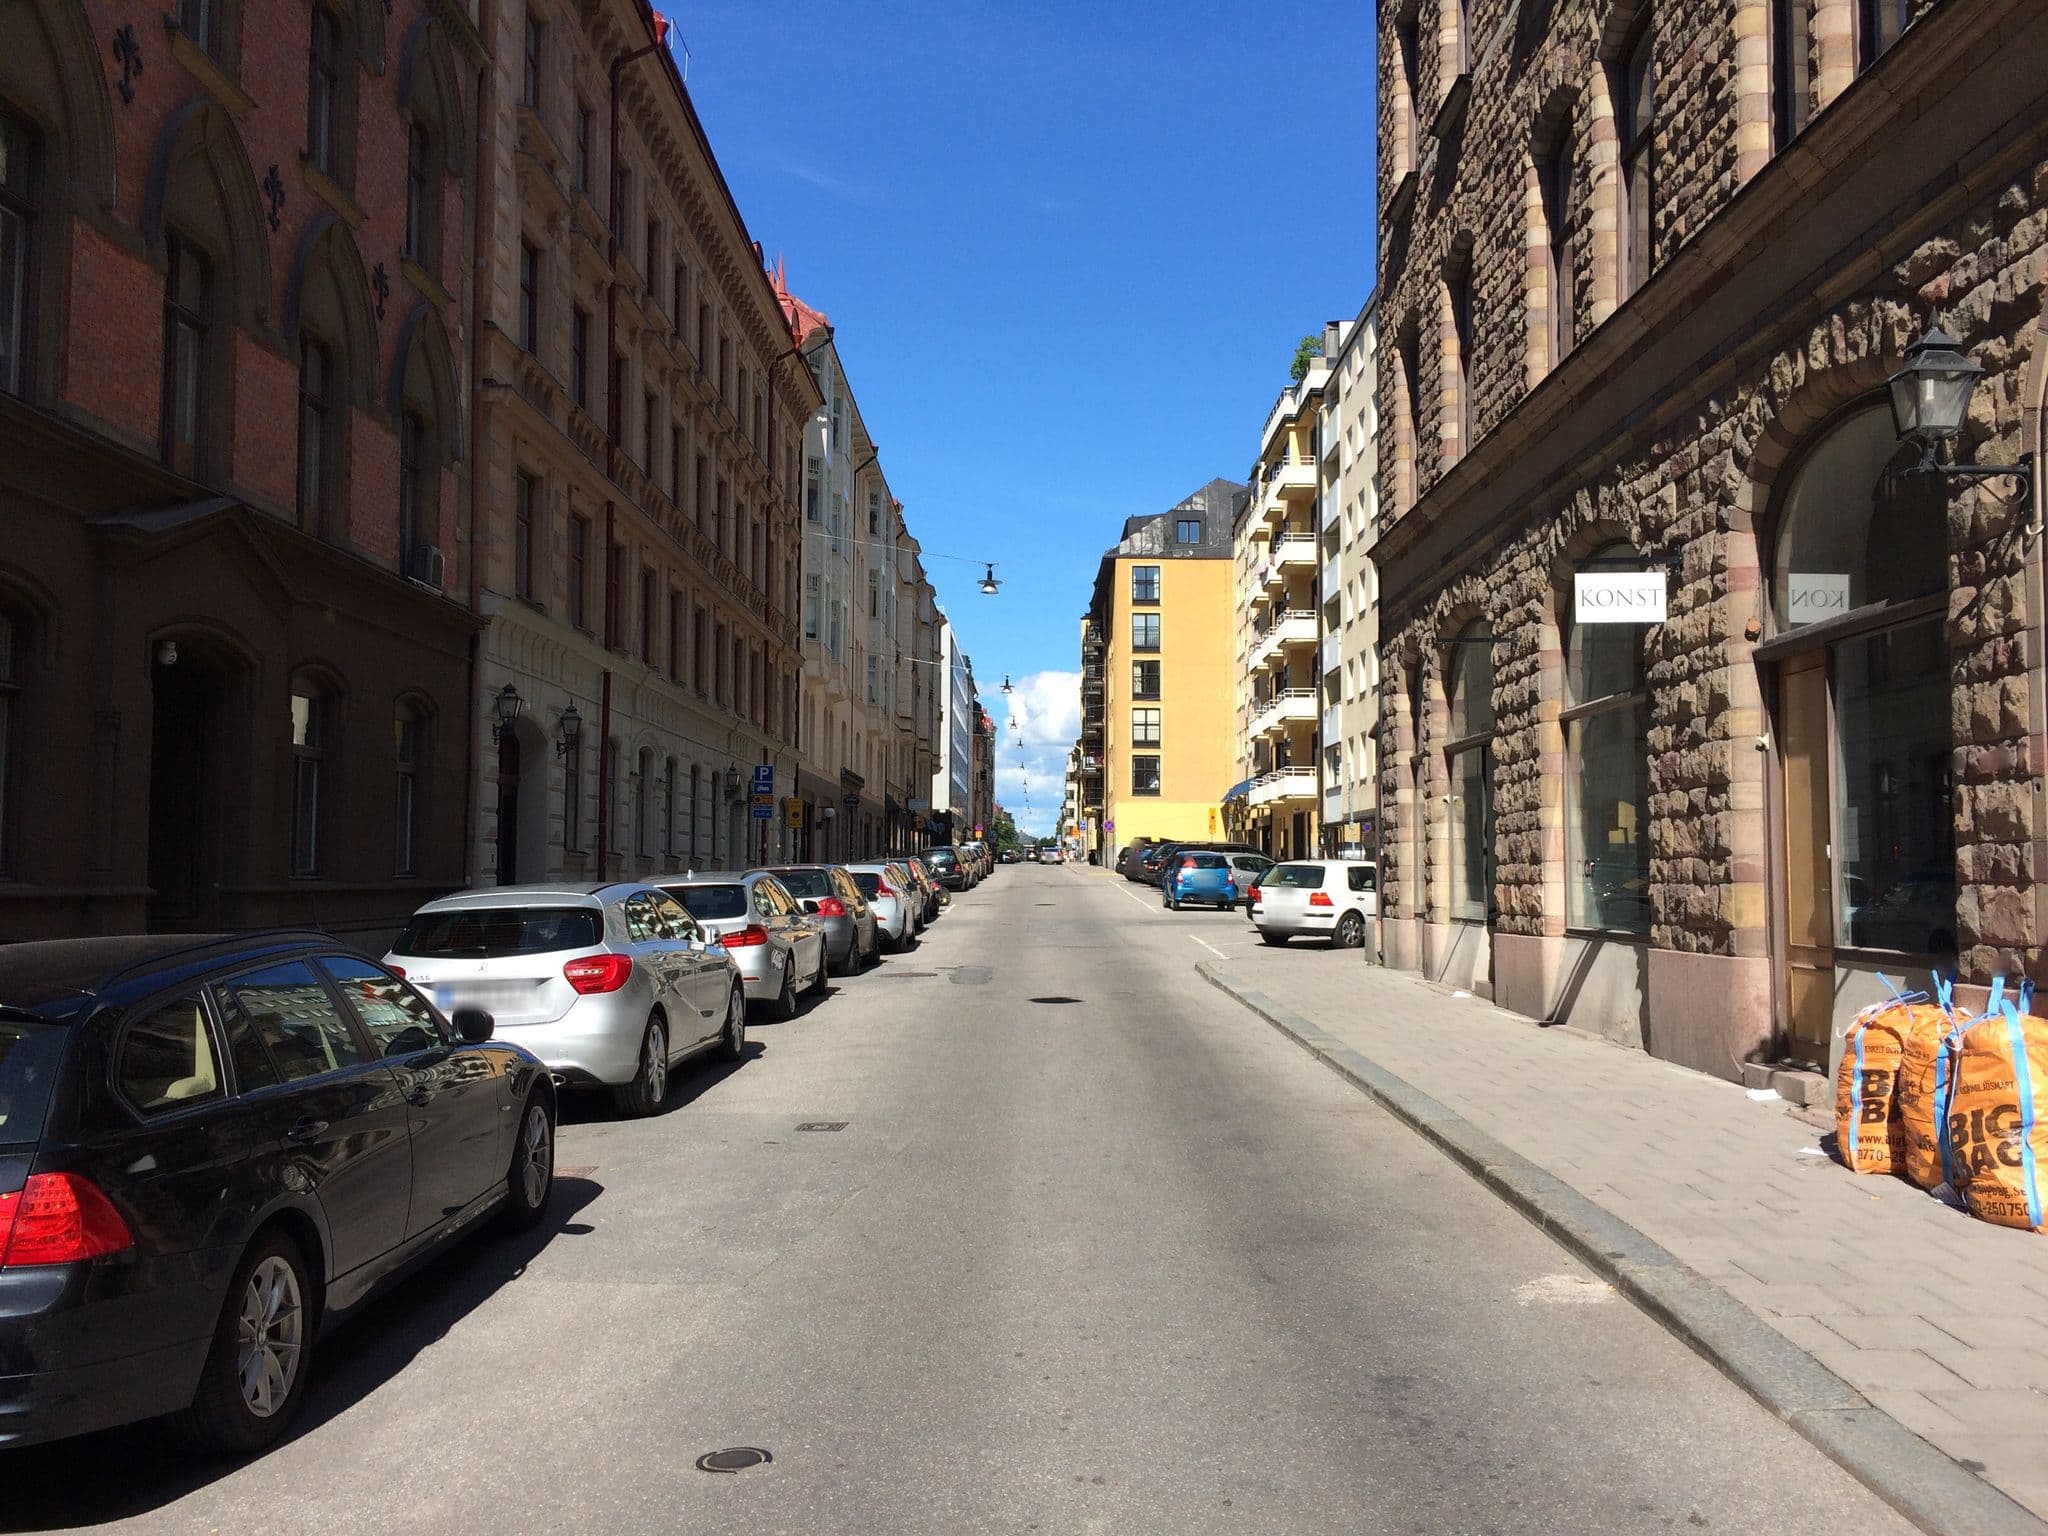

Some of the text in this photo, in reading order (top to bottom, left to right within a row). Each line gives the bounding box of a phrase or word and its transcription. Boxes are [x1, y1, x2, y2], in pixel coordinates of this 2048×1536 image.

[1580, 588, 1663, 607] KONST
[760, 767, 769, 780] P
[1949, 1104, 2022, 1149] BIG
[1952, 1141, 2023, 1187] BAG
